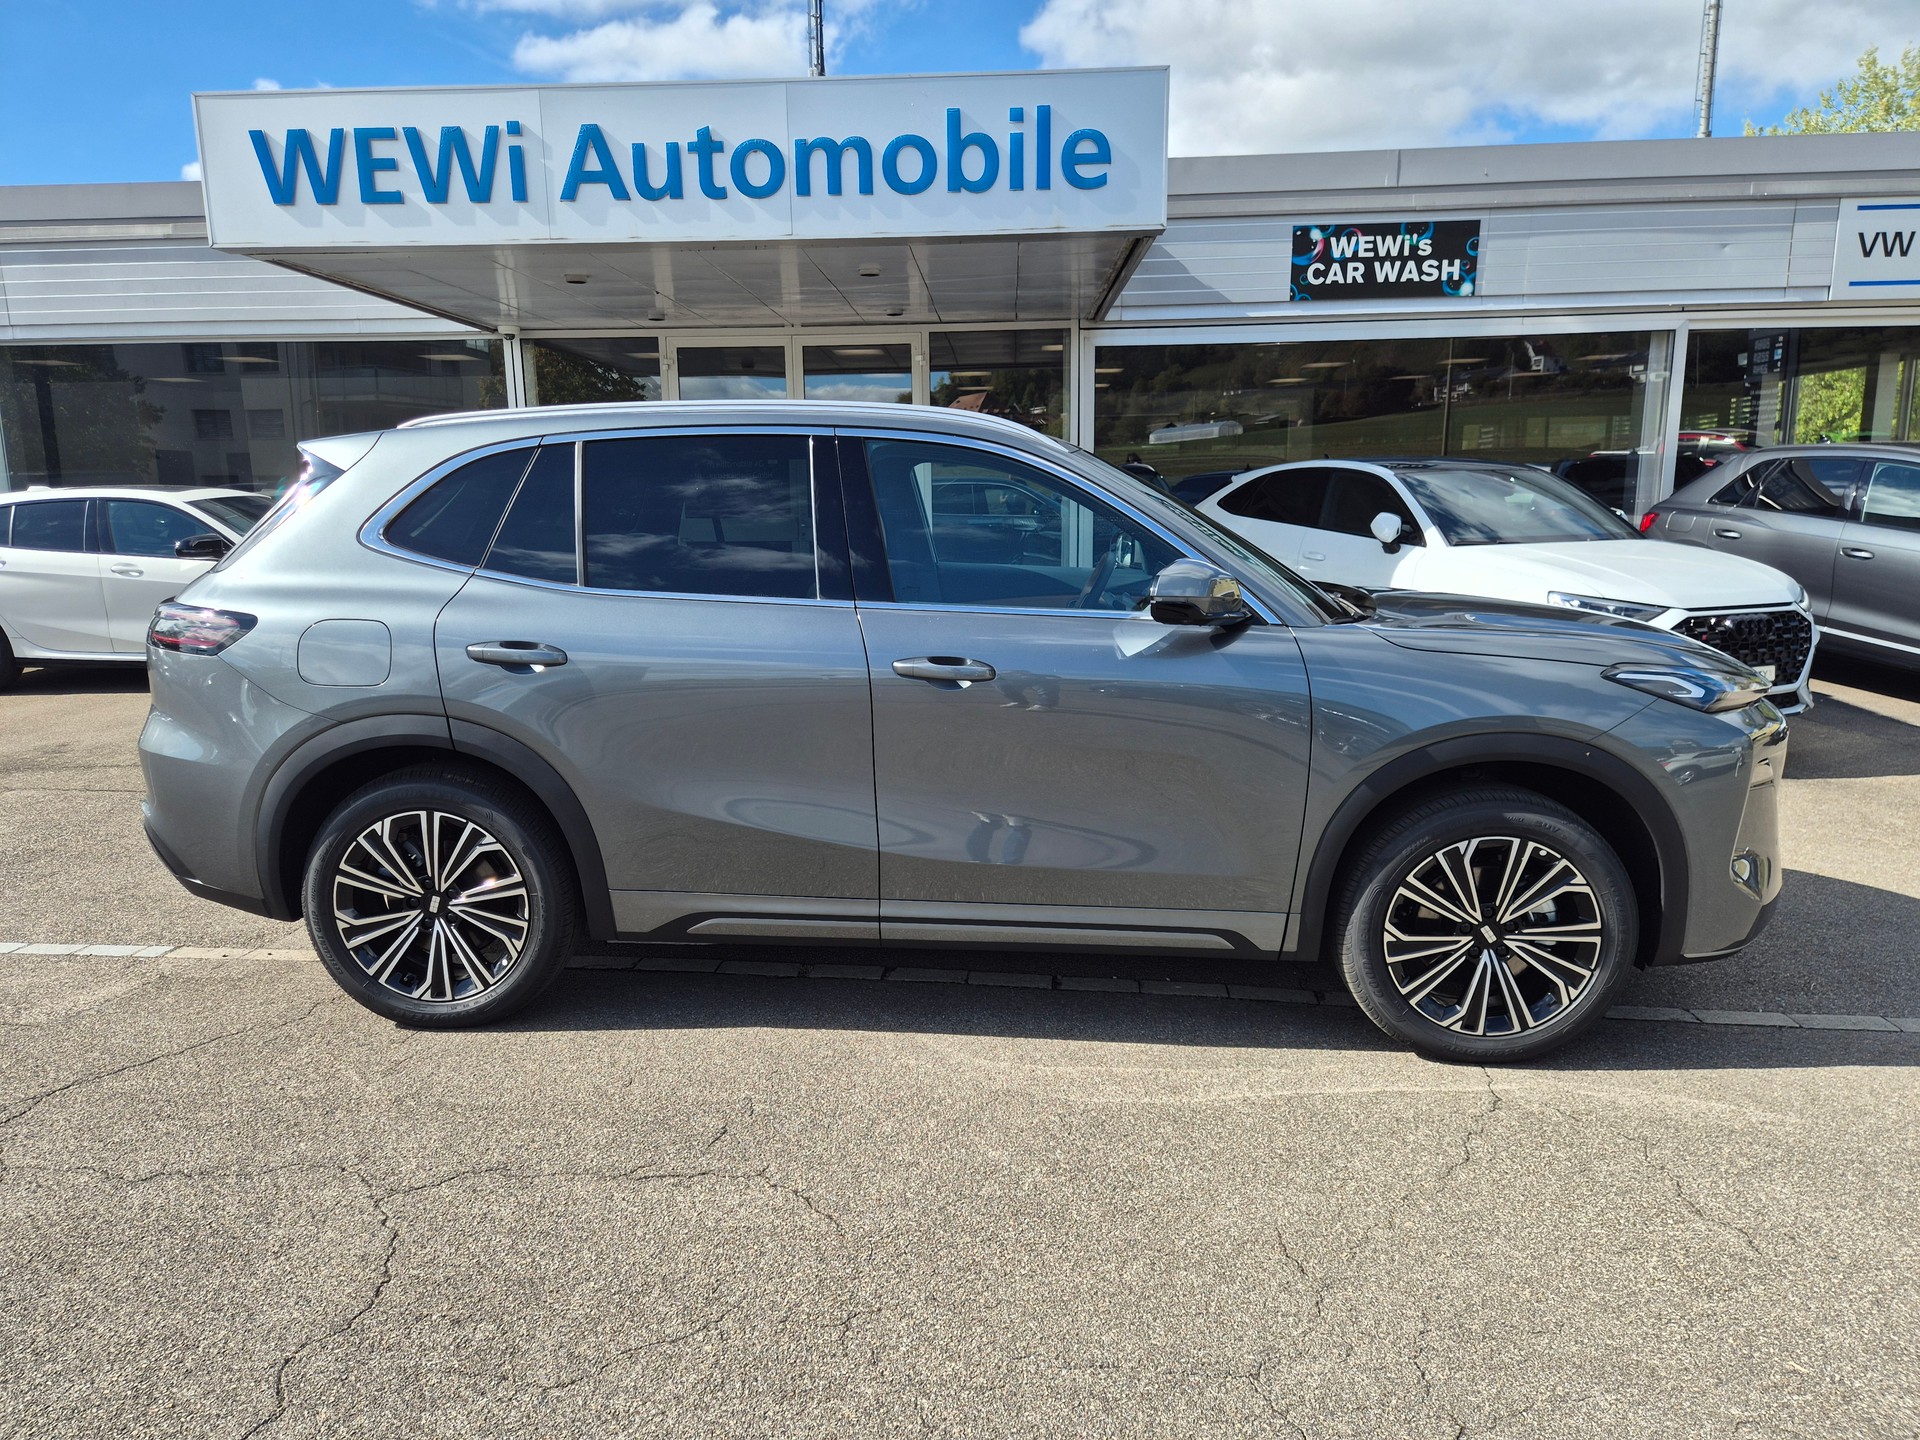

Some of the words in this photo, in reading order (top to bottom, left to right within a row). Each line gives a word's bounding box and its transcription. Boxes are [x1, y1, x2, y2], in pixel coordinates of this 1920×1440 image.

[248, 120, 528, 206] WEWi
[559, 104, 1112, 202] Automobile
[1330, 233, 1433, 258] WEWi's
[1857, 231, 1917, 257] VW
[1307, 262, 1365, 285] CAR
[1374, 258, 1461, 283] WASH
